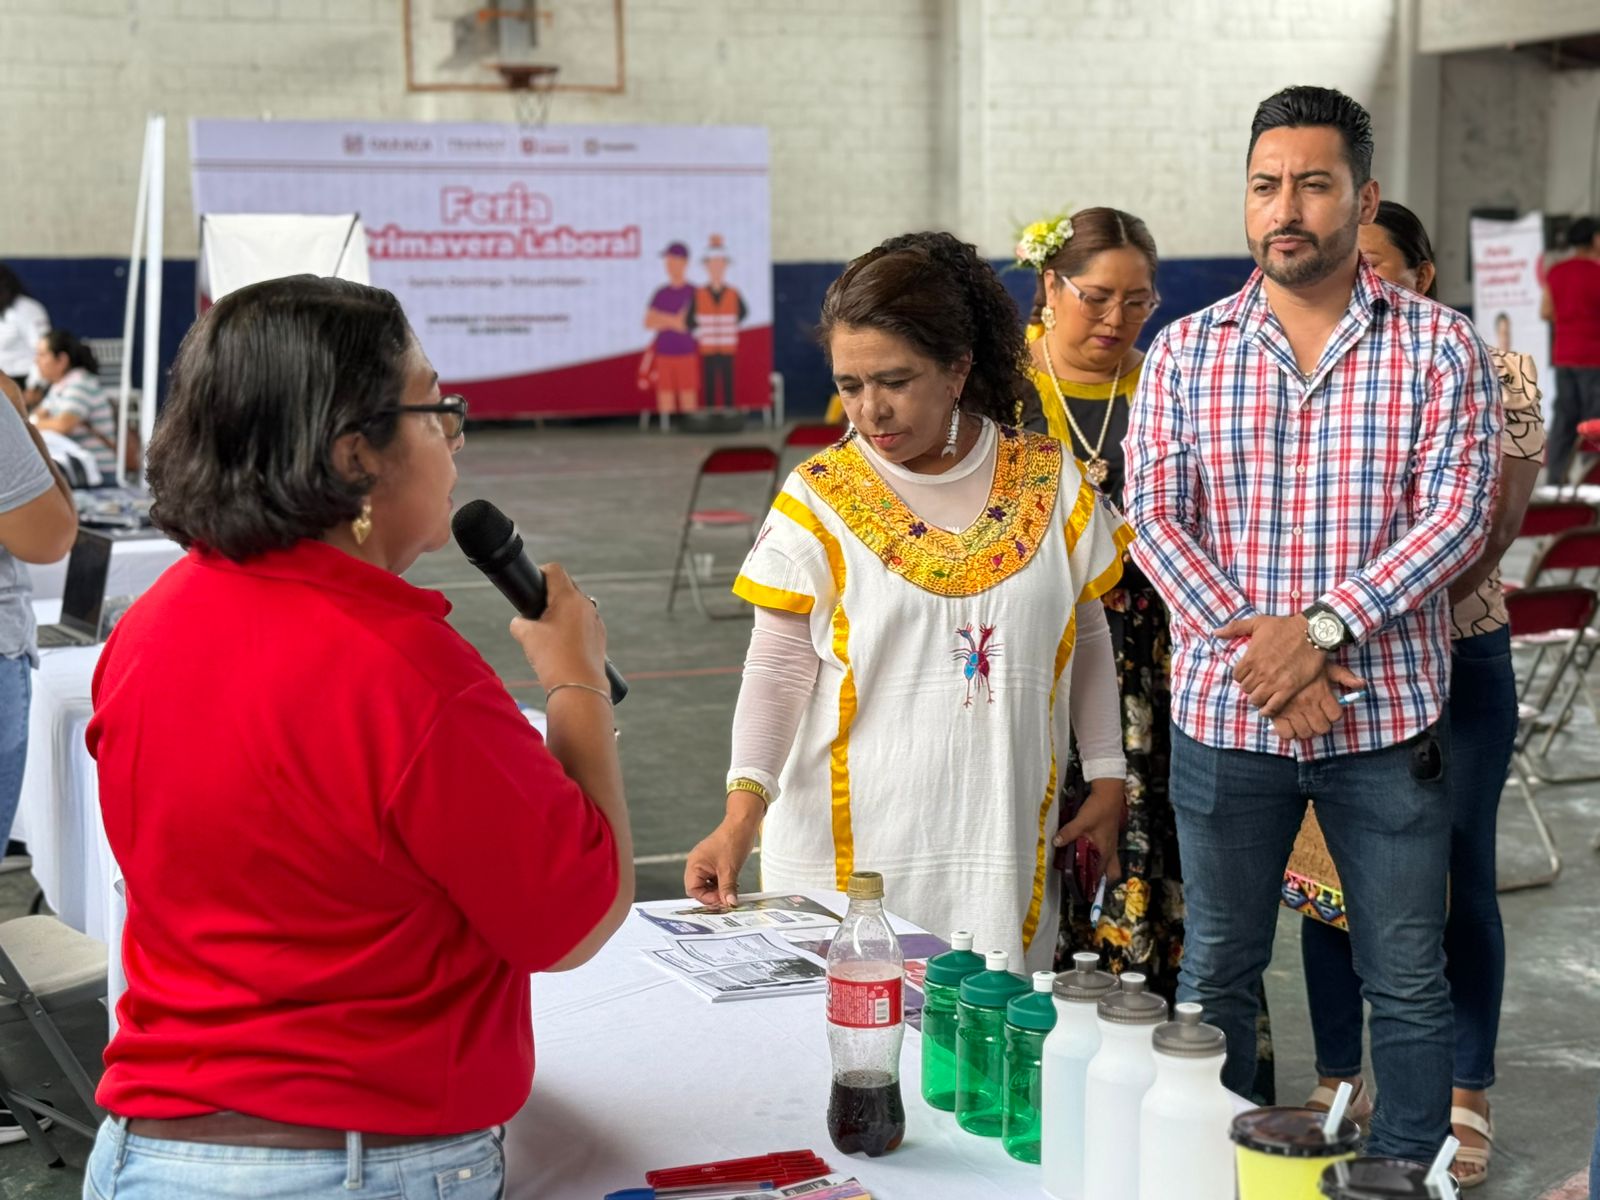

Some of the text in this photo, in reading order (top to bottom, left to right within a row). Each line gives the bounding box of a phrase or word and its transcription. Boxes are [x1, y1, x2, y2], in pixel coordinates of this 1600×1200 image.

[440, 183, 552, 225] Feria
[367, 225, 641, 260] rimavera Laboral
